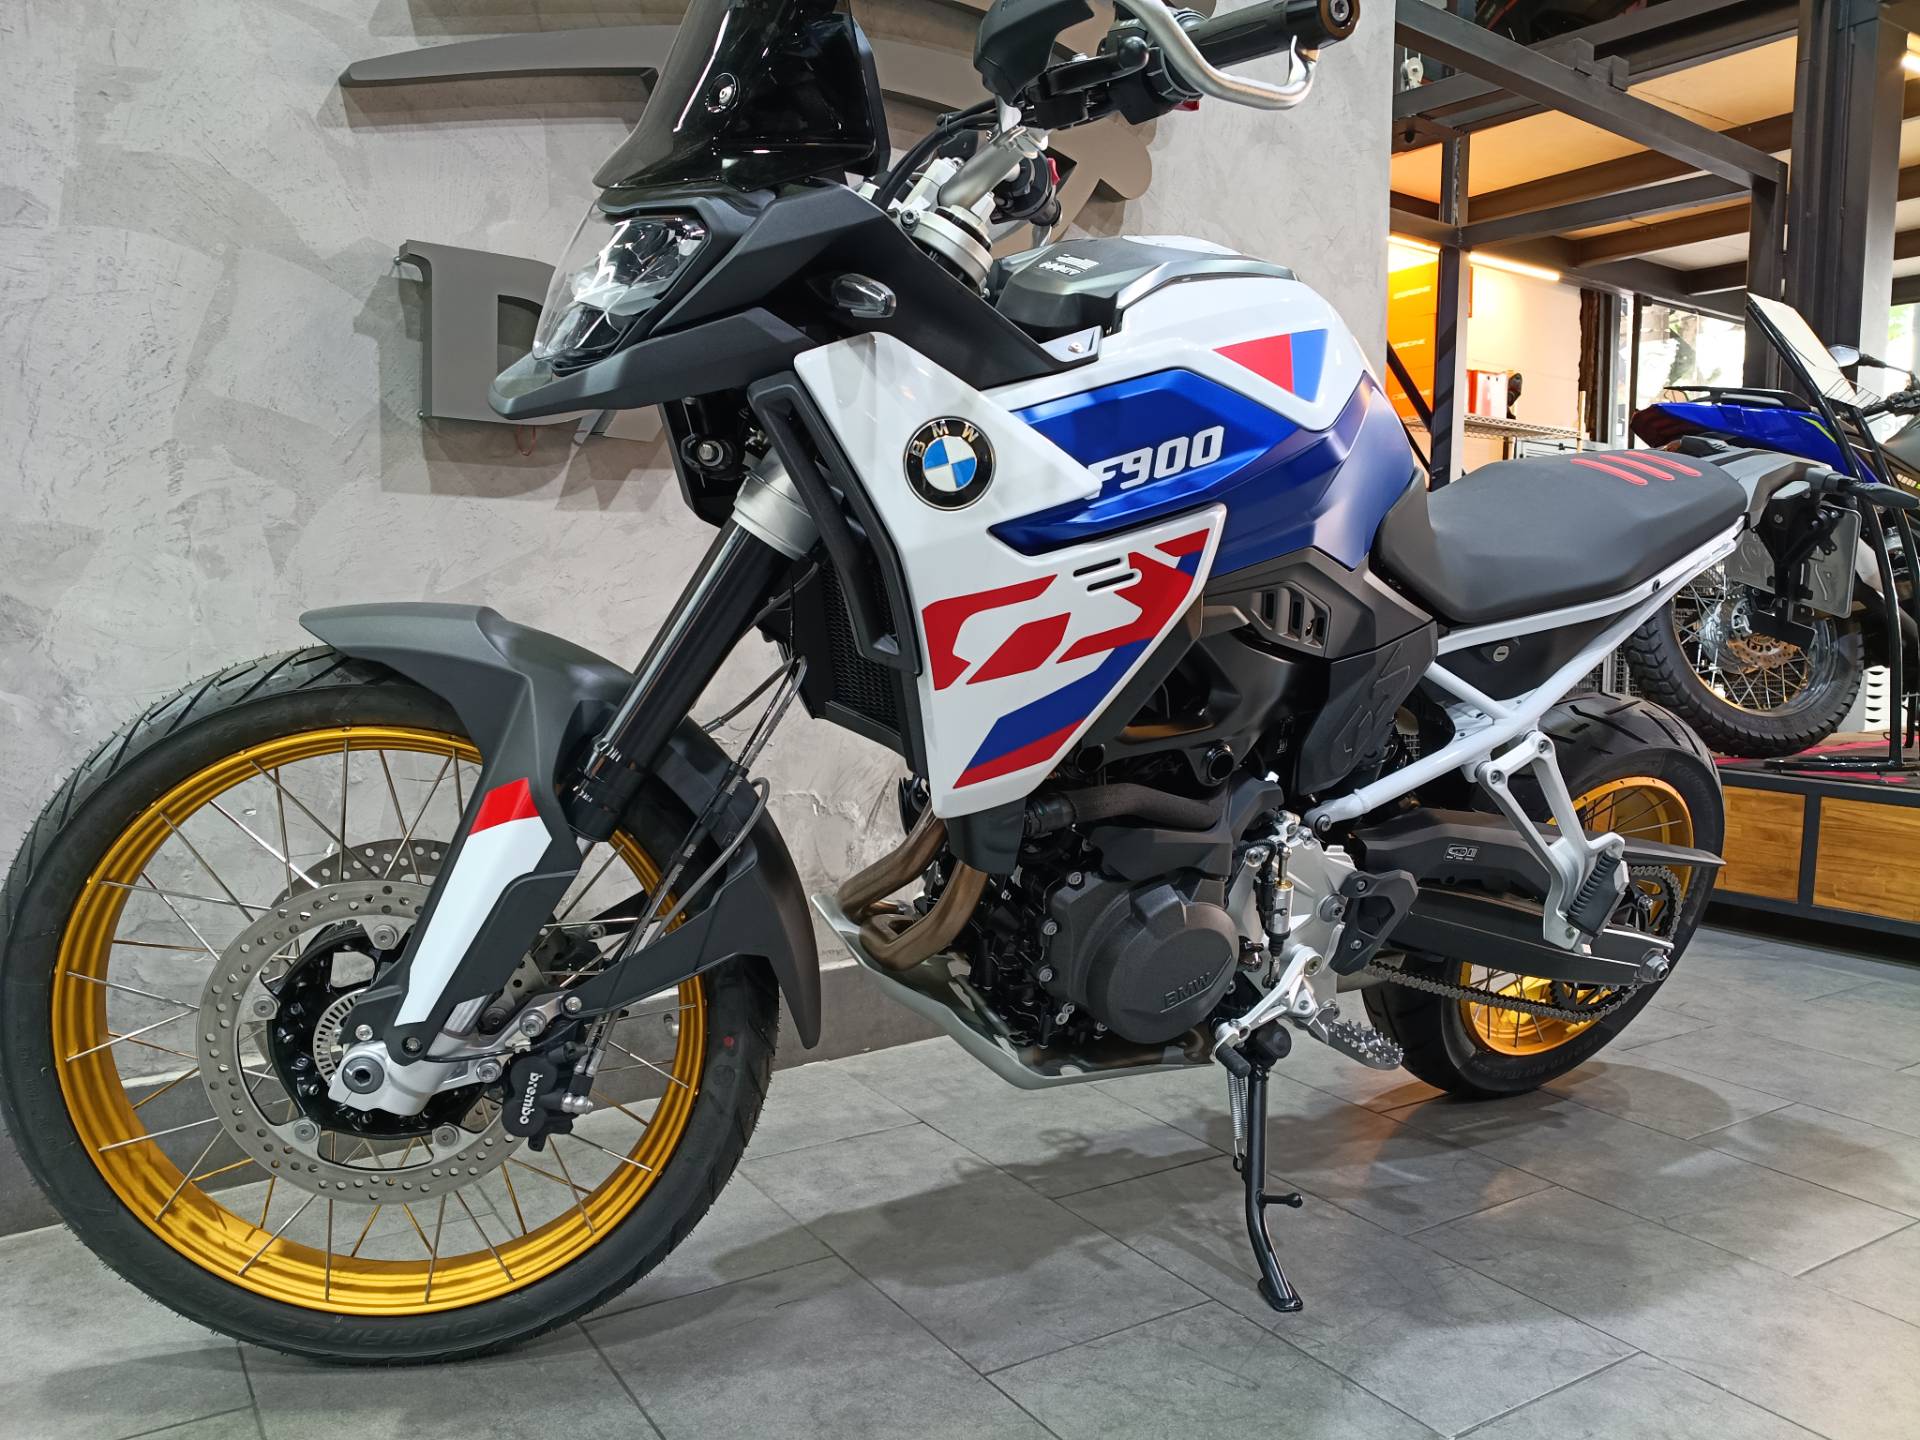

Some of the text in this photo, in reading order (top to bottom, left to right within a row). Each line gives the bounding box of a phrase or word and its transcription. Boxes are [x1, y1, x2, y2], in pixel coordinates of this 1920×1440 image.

[909, 419, 979, 458] BMW
[1084, 425, 1225, 500] F900
[1163, 971, 1212, 1006] BMW
[519, 1072, 543, 1124] brembo
